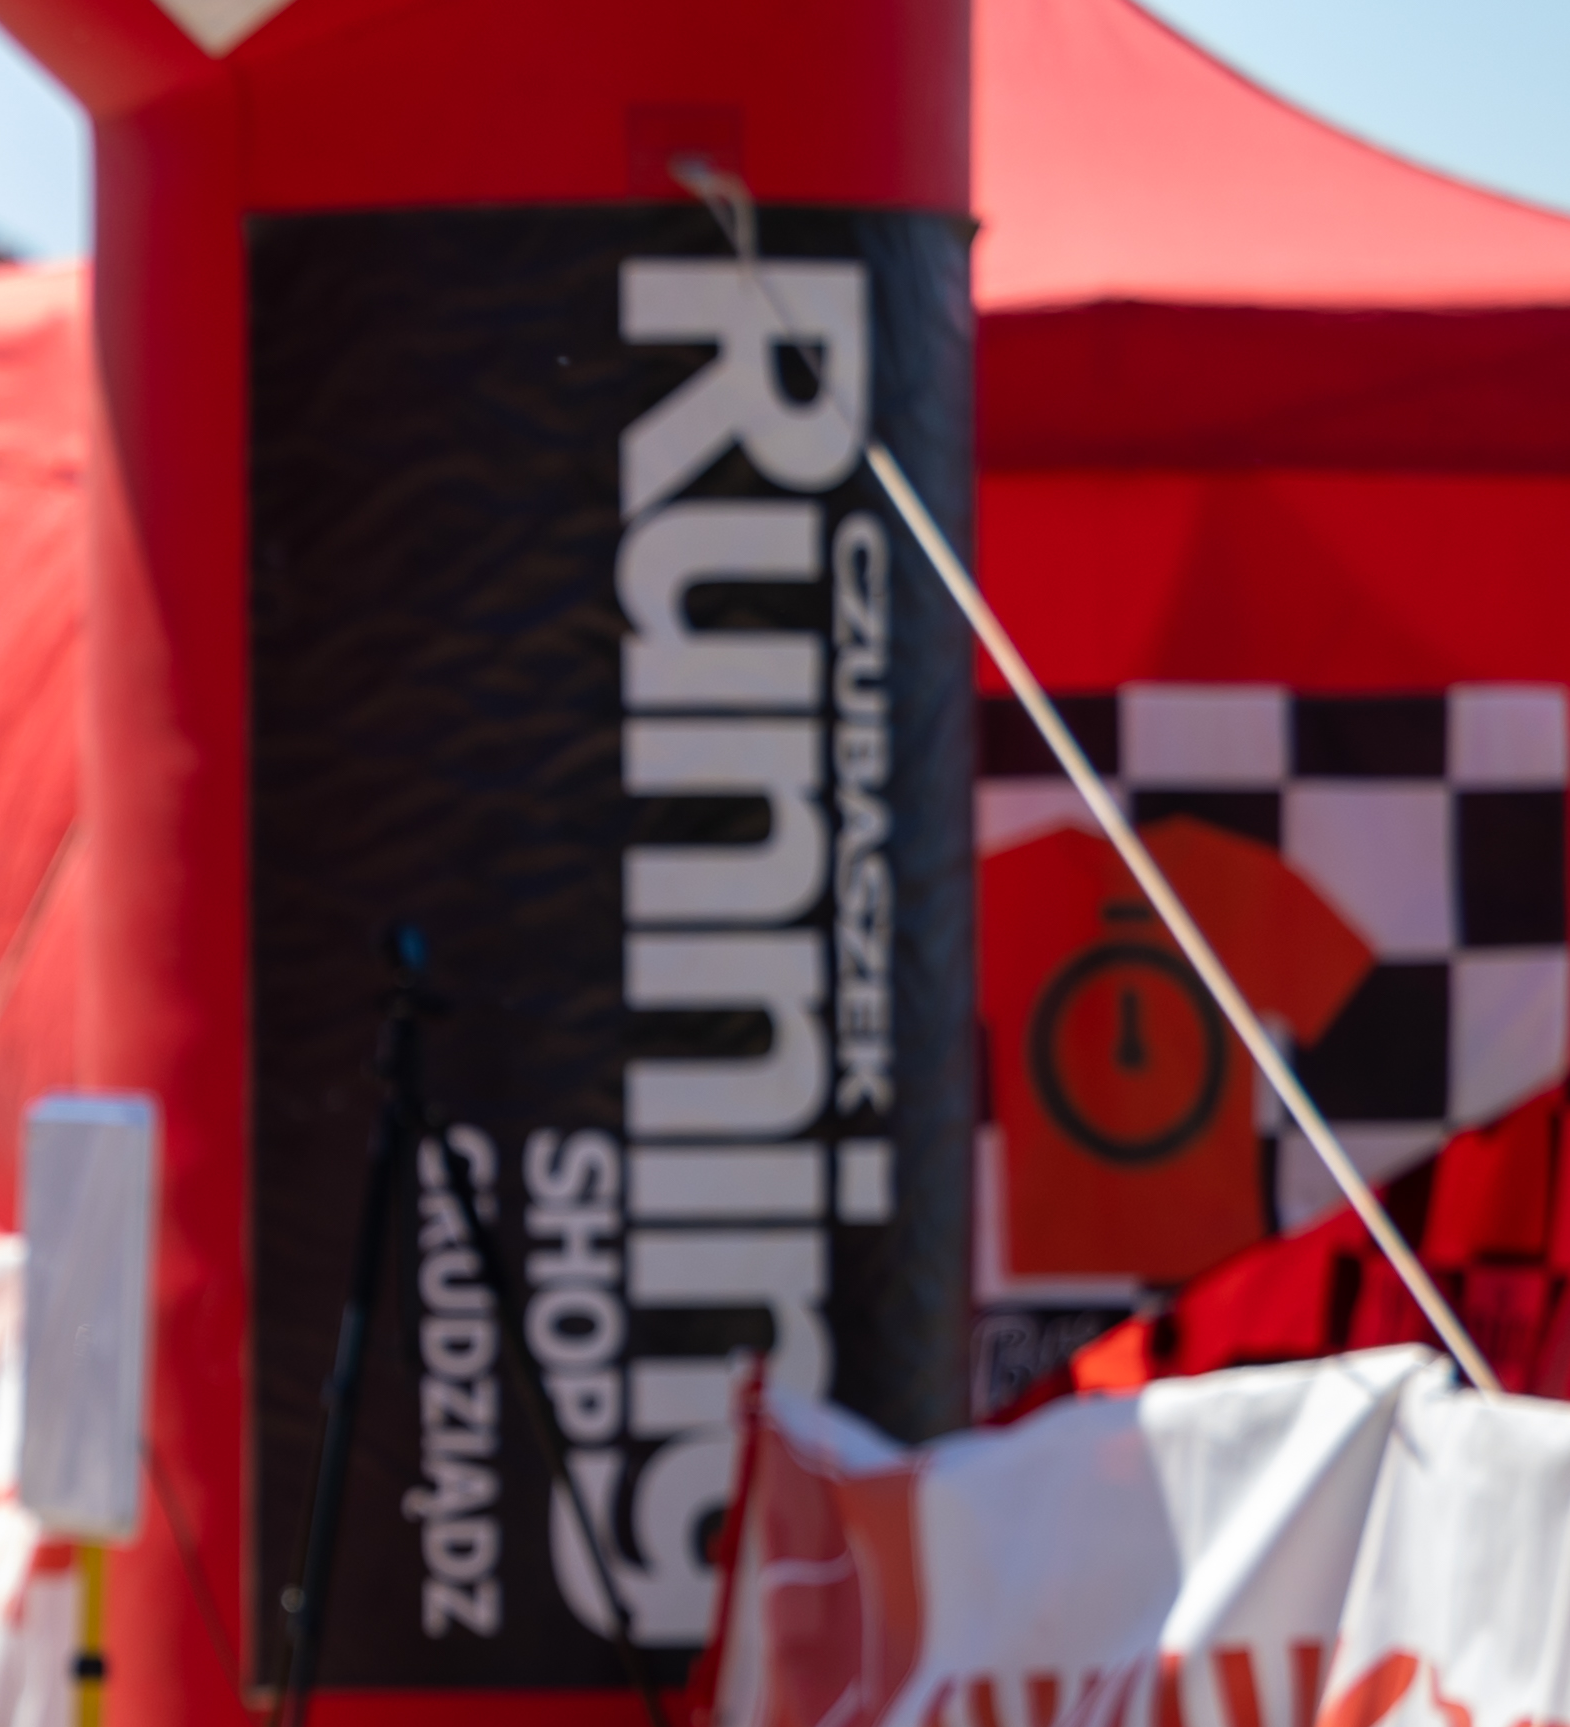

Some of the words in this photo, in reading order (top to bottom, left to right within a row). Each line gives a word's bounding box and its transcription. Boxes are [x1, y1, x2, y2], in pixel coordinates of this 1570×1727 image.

[548, 259, 893, 1646] Running
[833, 512, 894, 1115] CZUBASZEK
[523, 1128, 622, 1440] SHOP
